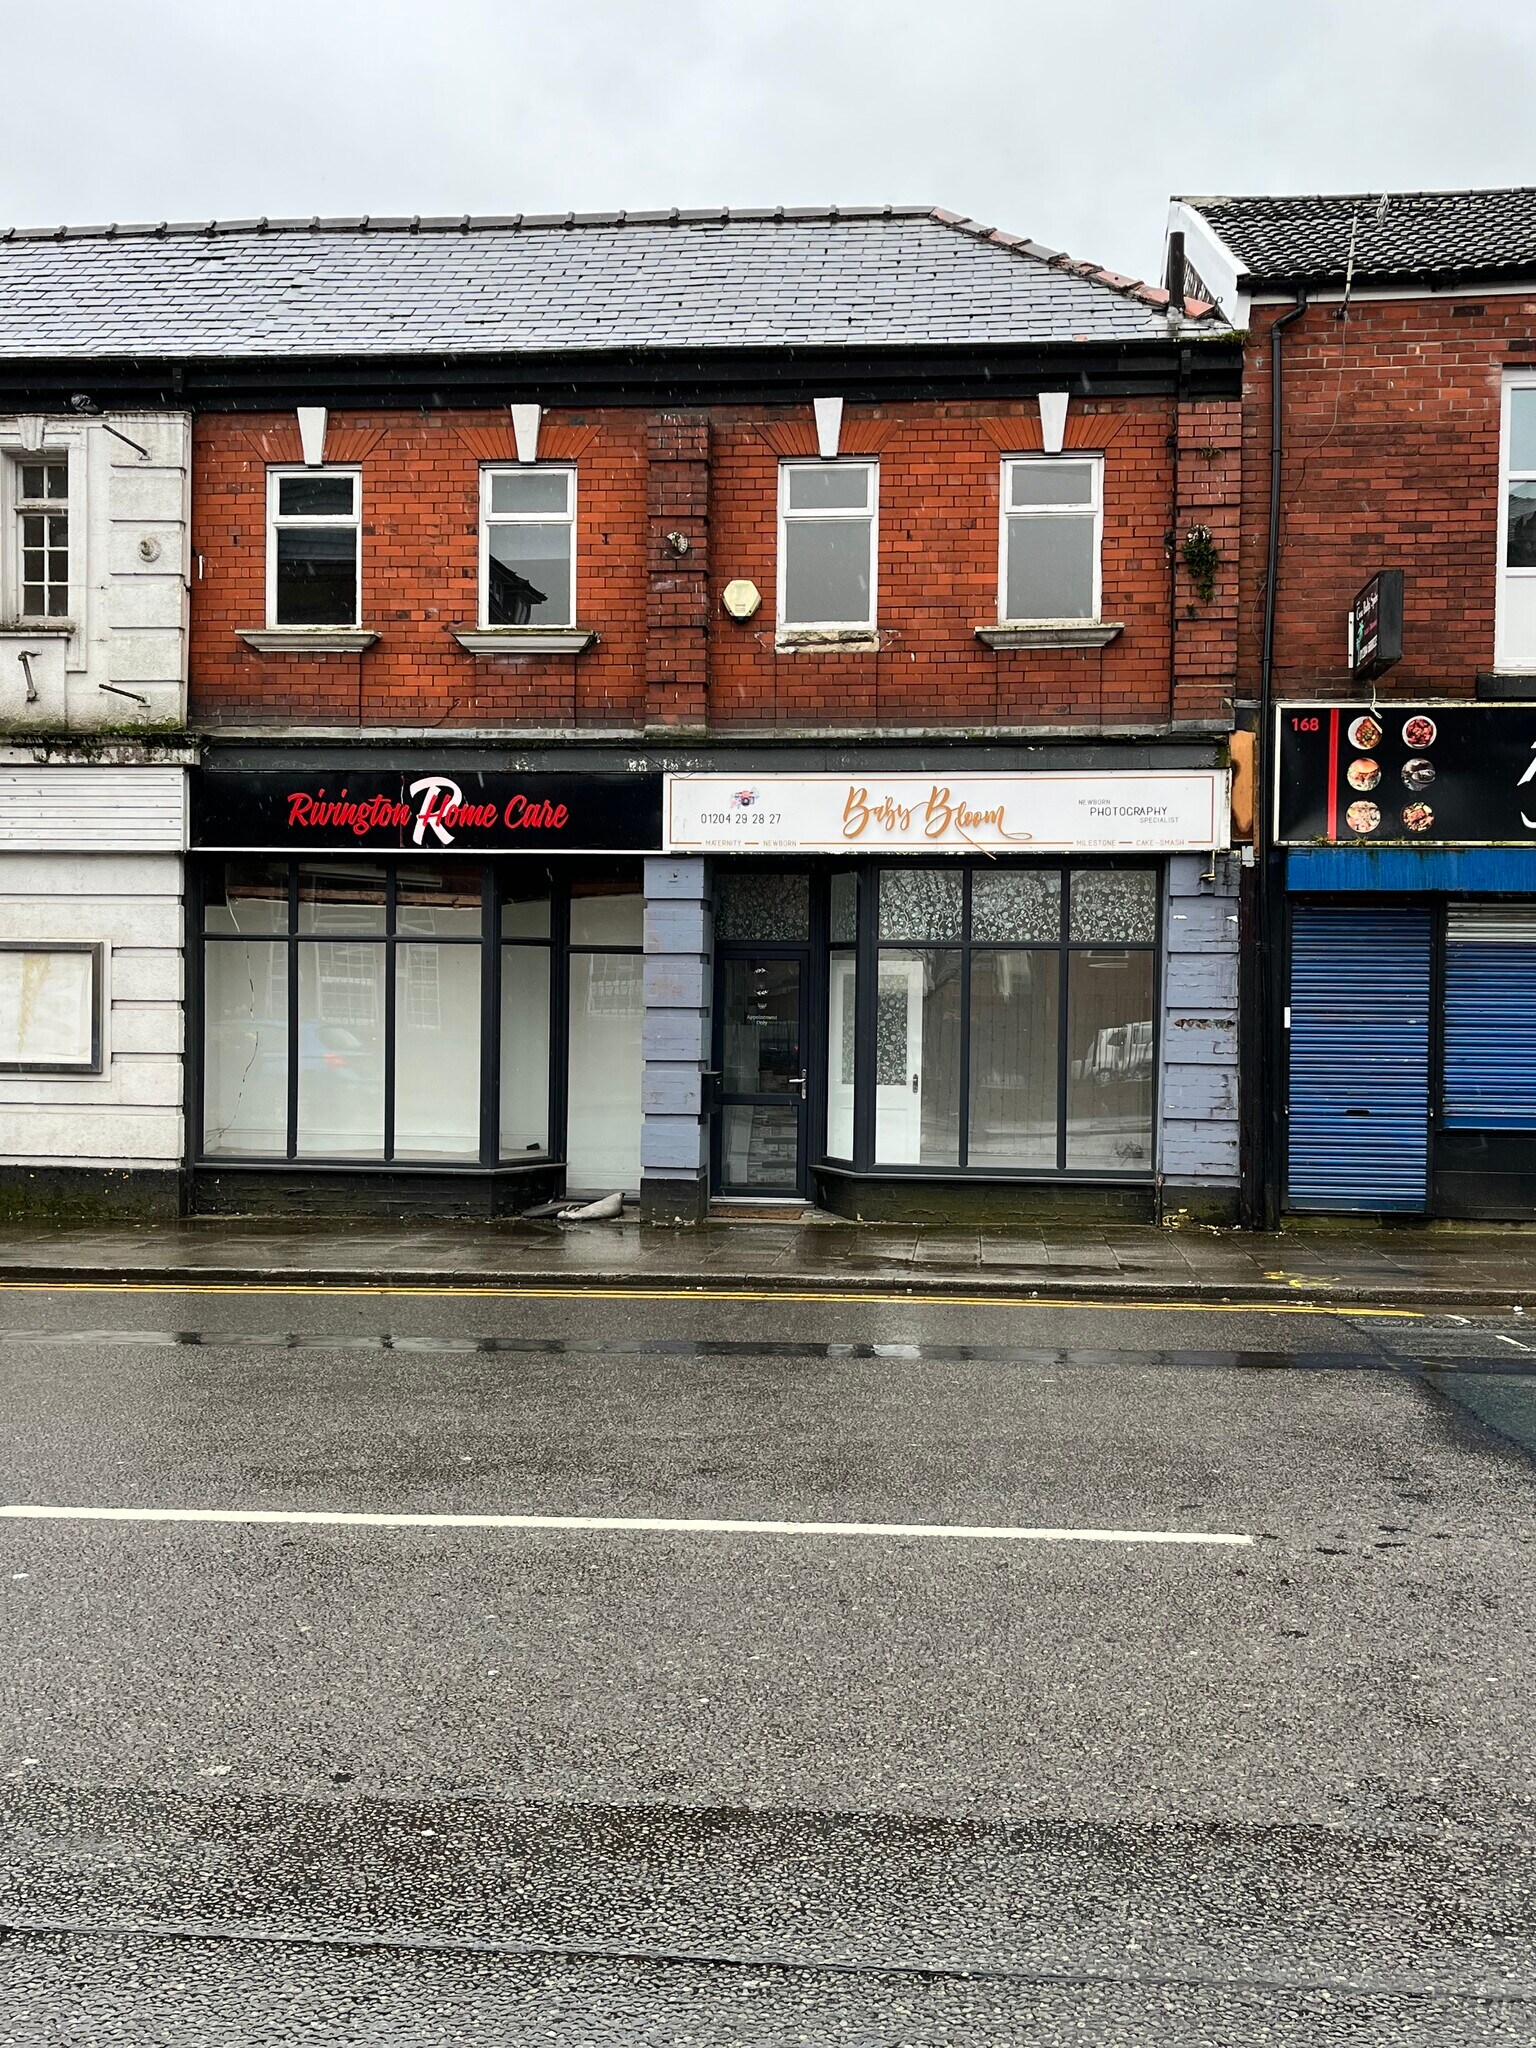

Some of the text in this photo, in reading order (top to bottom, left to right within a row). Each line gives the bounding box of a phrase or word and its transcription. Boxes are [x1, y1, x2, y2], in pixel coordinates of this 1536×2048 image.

[1291, 717, 1319, 732] 168
[287, 789, 569, 836] Rivington Home Care
[1089, 806, 1168, 816] PHOTOGRAPHY
[700, 813, 781, 825] 01204 29 28 27
[842, 785, 1033, 860] Baby Bloom
[1139, 816, 1180, 824] SPECIALIST
[705, 839, 742, 847] MATERNITY
[763, 839, 797, 847] NEWBORN
[1076, 838, 1116, 847] MILESTONE
